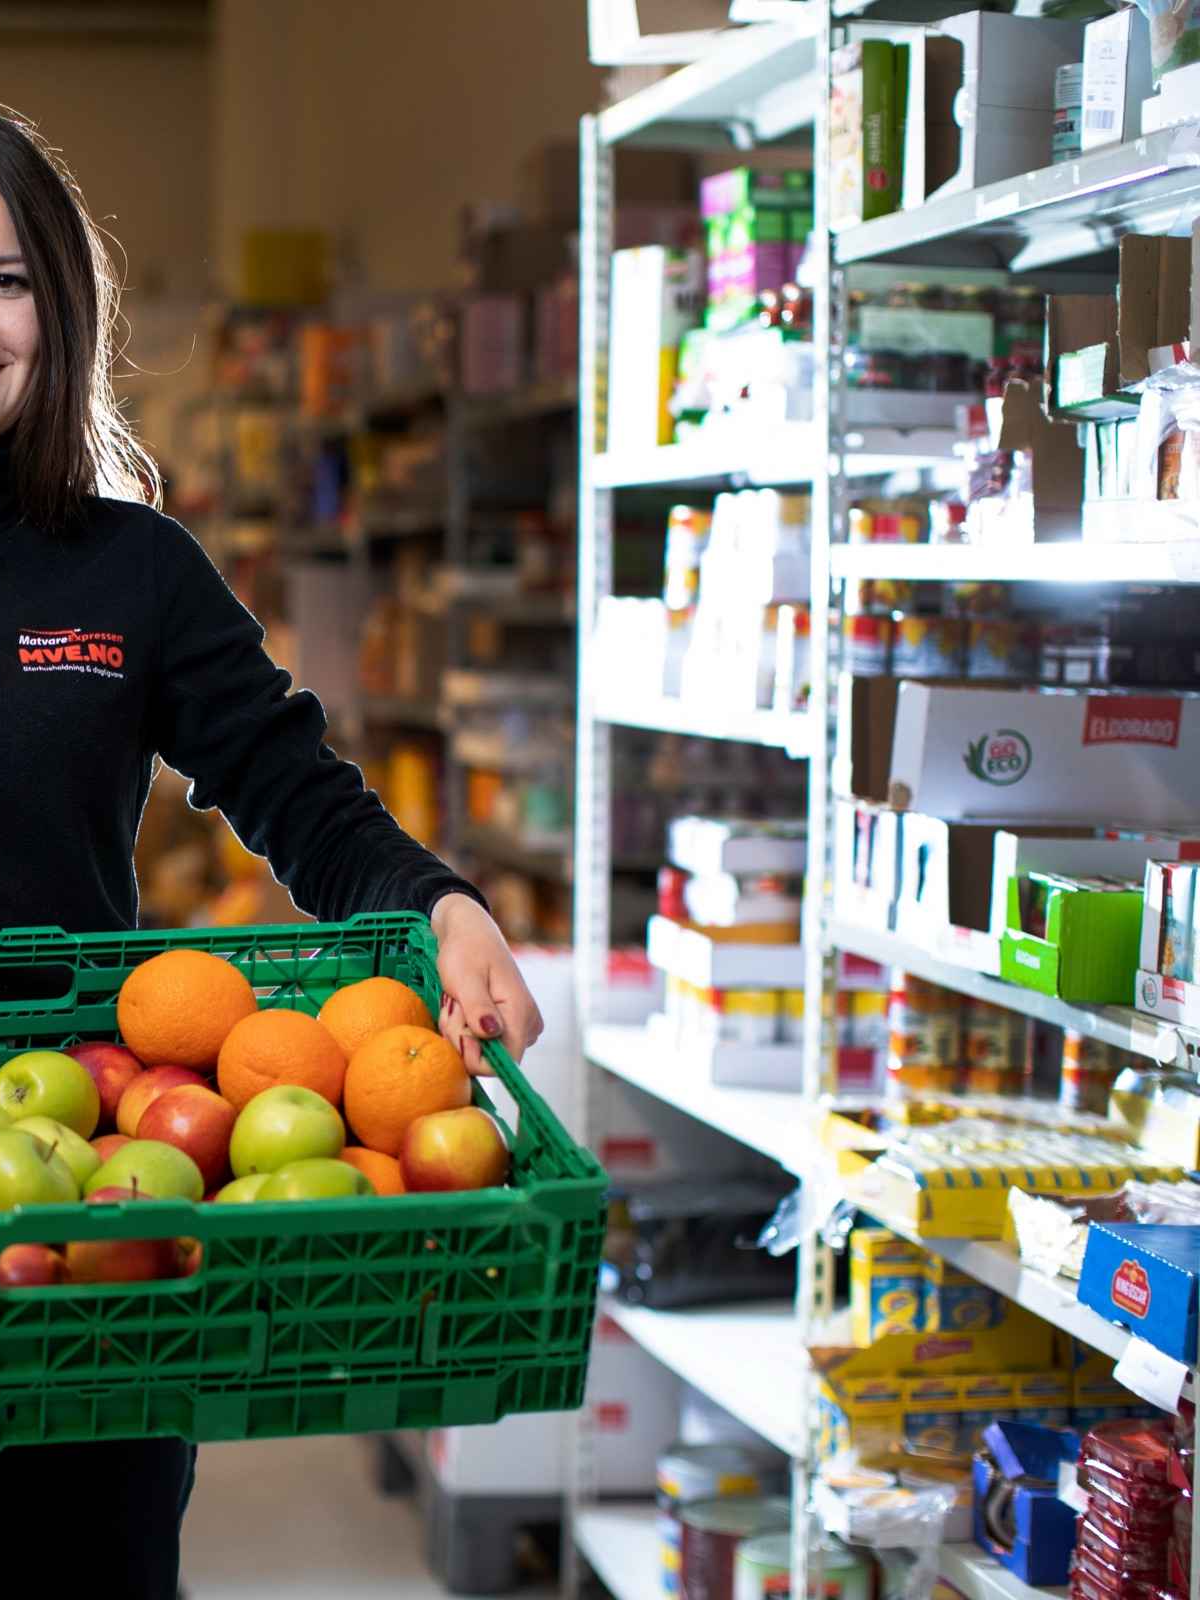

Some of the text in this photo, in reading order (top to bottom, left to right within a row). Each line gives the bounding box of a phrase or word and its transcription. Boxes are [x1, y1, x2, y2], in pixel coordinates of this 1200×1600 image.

[18, 632, 124, 645] MatvareExpressen
[19, 643, 124, 668] MVE.NO
[1091, 717, 1174, 741] ELDORADO
[990, 740, 1018, 759] GO
[987, 756, 1022, 773] ECO
